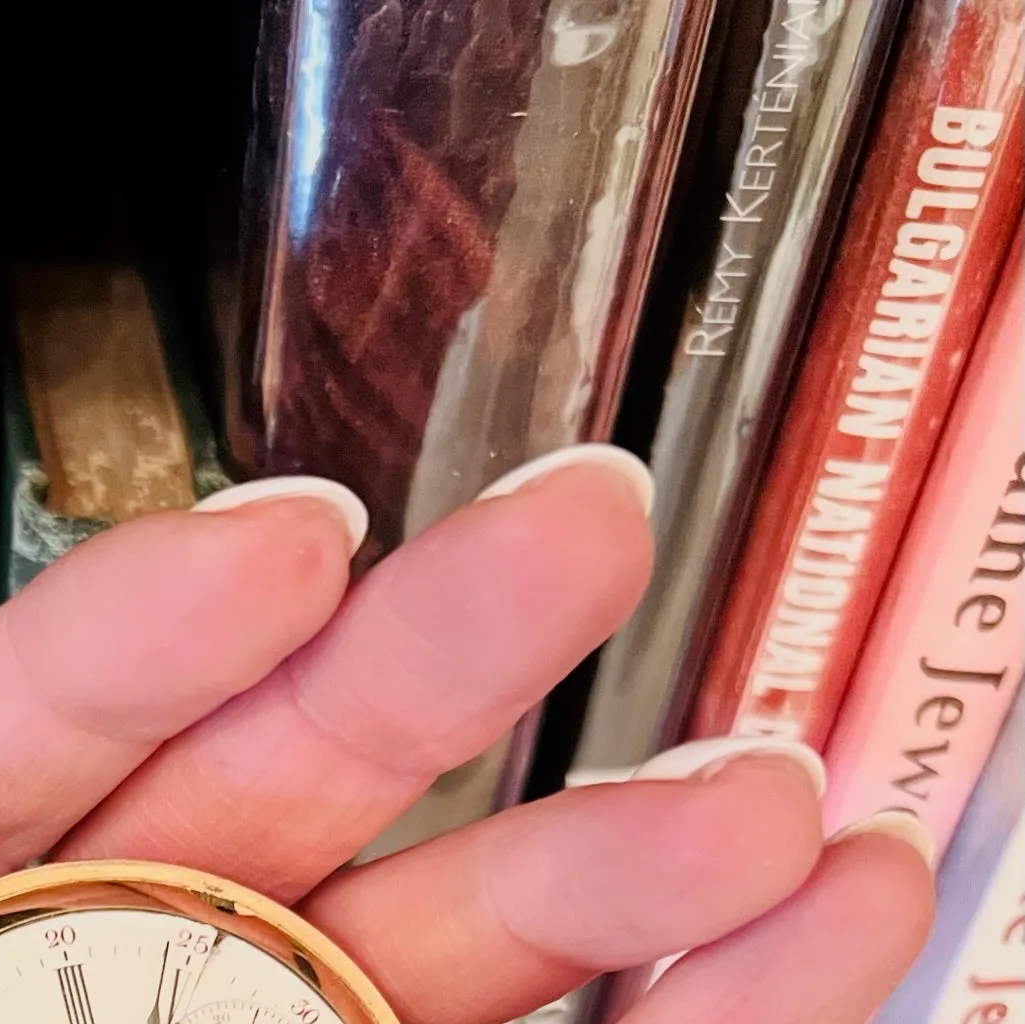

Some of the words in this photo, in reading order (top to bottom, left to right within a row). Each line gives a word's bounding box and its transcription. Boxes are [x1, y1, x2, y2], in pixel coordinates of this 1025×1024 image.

[684, 243, 753, 357] RÉMY
[719, 0, 821, 223] KERTÉNIA
[837, 105, 1004, 440] BULGARIAN
[751, 459, 891, 696] NATIONAL
[877, 655, 1009, 818] Jew
[43, 925, 77, 949] 20
[175, 928, 211, 955] 25
